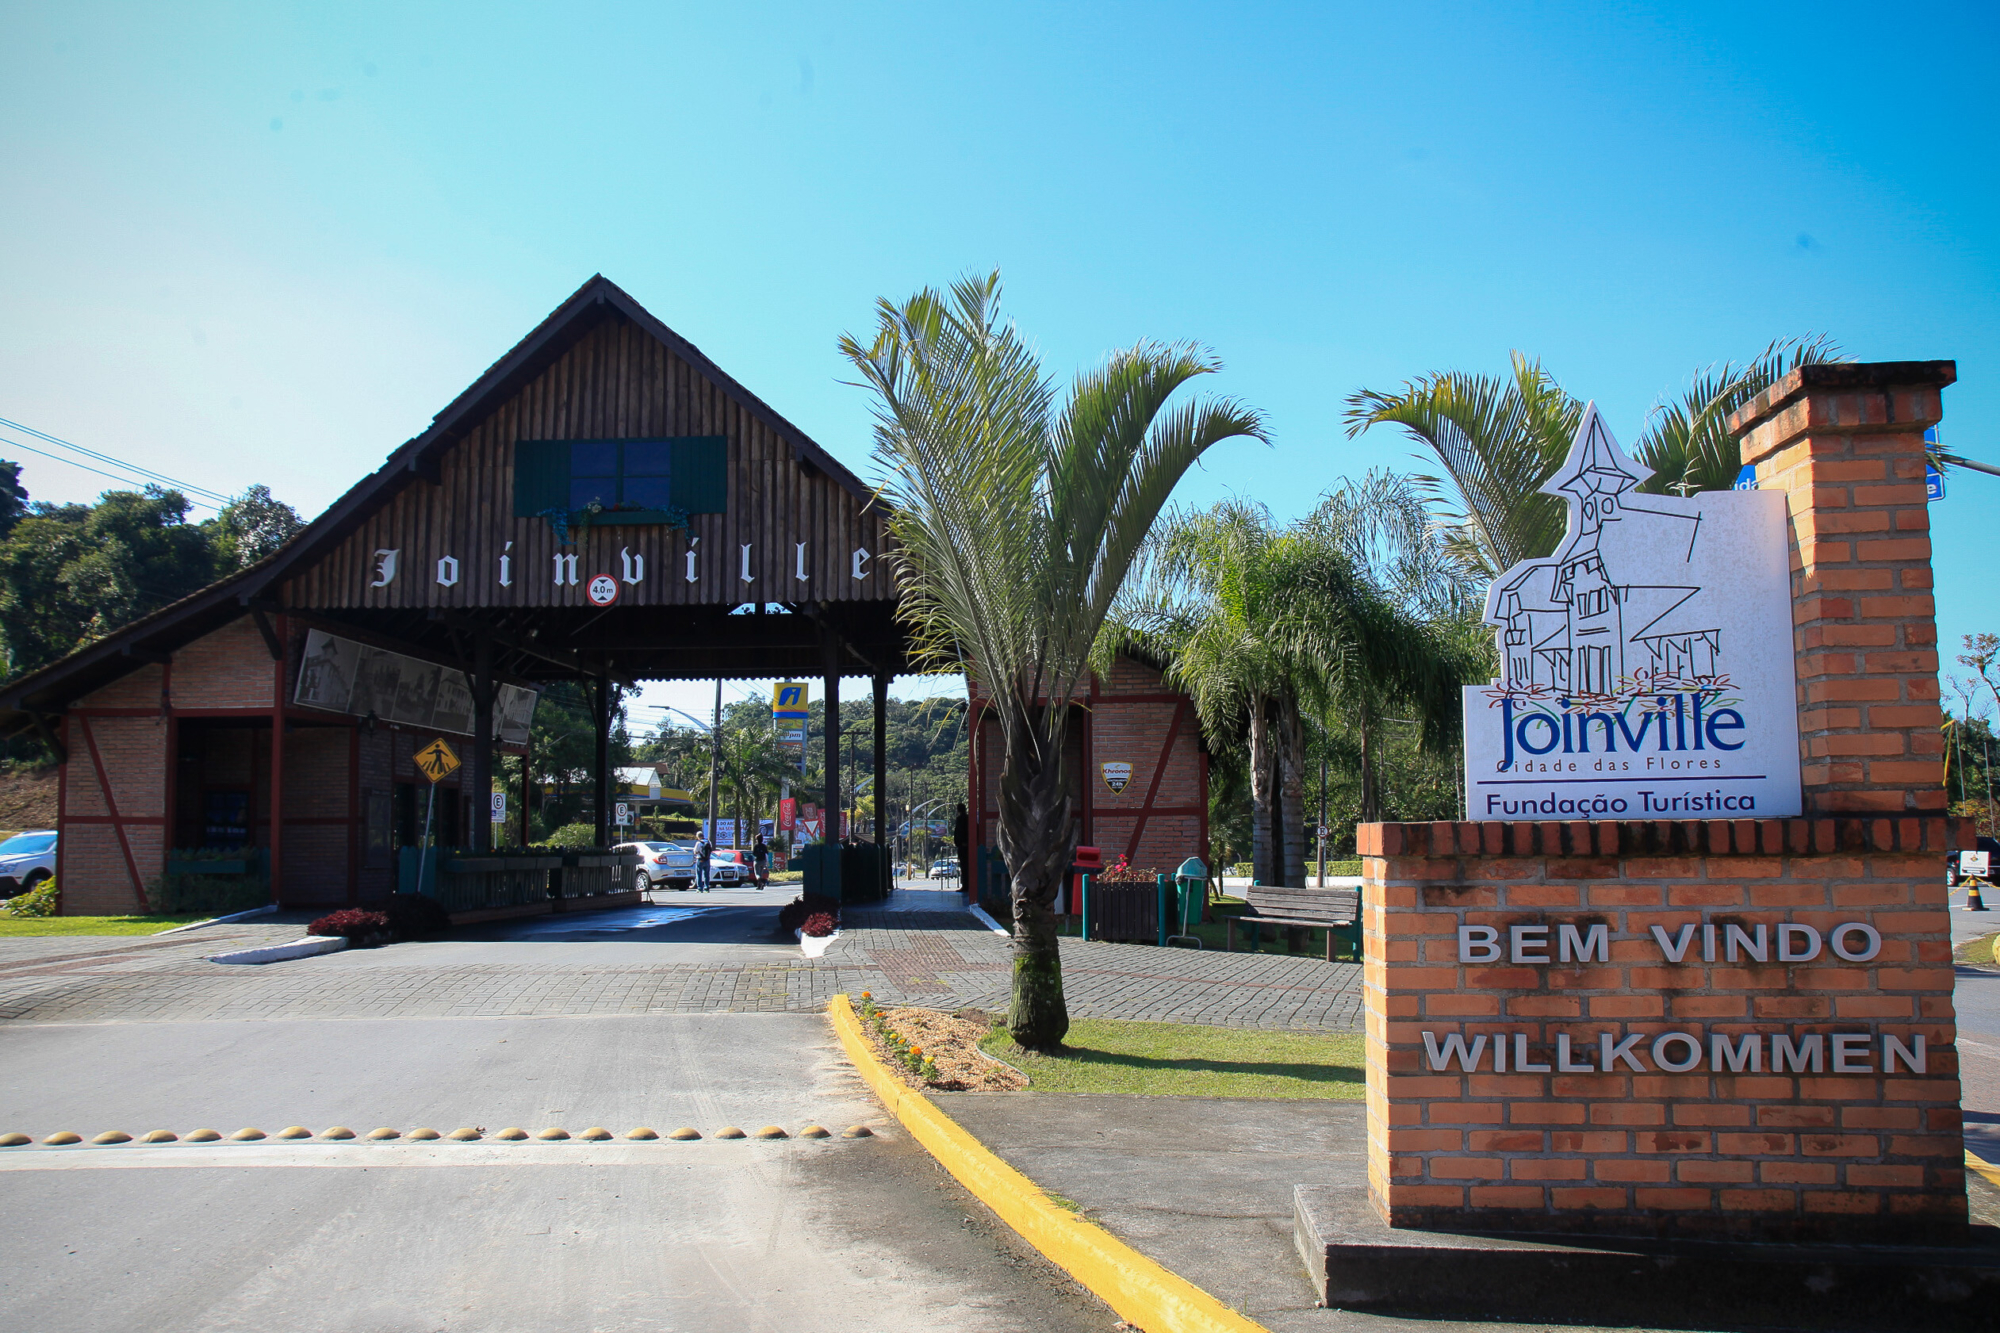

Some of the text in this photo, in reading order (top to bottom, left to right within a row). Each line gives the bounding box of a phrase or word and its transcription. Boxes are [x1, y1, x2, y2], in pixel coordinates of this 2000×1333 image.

[370, 538, 871, 588] Joinville
[1496, 693, 1746, 773] Joinville
[1496, 757, 1721, 773] Cidade das Flores
[1487, 789, 1755, 819] Fundação Turística
[1458, 922, 1882, 964] BEM VINDO
[1421, 1031, 1927, 1074] WILLKOMMEN
